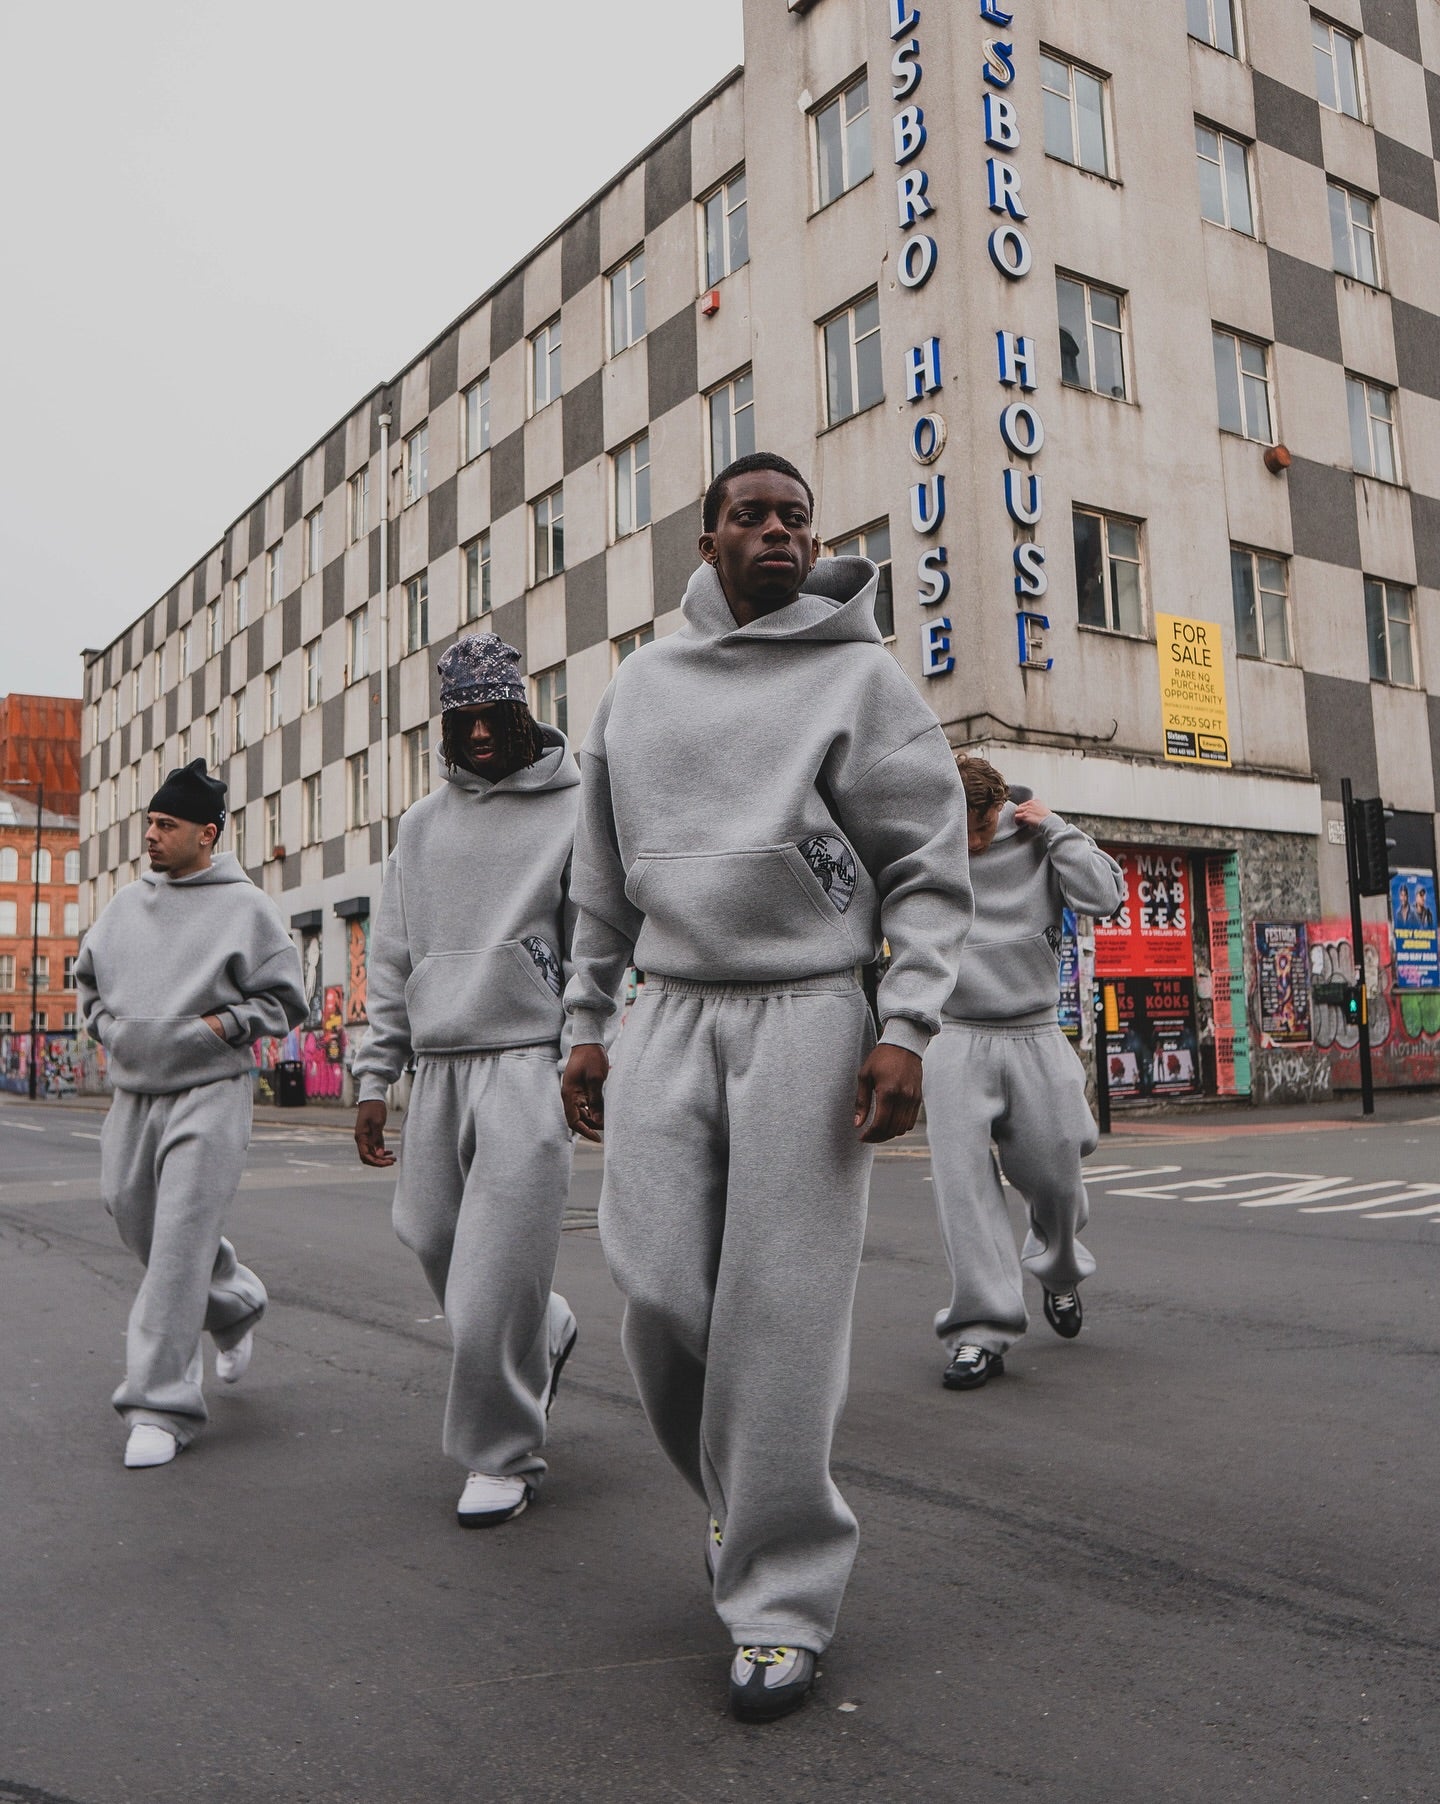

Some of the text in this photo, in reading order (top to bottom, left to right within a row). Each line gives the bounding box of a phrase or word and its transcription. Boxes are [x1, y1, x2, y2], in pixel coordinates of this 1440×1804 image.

[904, 336, 955, 679] HOUSE
[996, 329, 1054, 671] HOUSE
[1173, 622, 1207, 646] FOR
[1171, 643, 1212, 668] SALE
[1171, 678, 1215, 694] PURCHASE
[1174, 668, 1210, 683] RARE NQ
[1164, 688, 1223, 705] OPPORTUNITY
[1198, 717, 1211, 729] SQ
[1212, 720, 1222, 731] FT
[1135, 855, 1183, 878] MAC
[1138, 881, 1185, 904] CAB
[1140, 907, 1187, 929] EES
[1153, 982, 1181, 993] THE
[1145, 995, 1190, 1009] KOOKS
[1104, 1171, 1440, 1223] ENT
